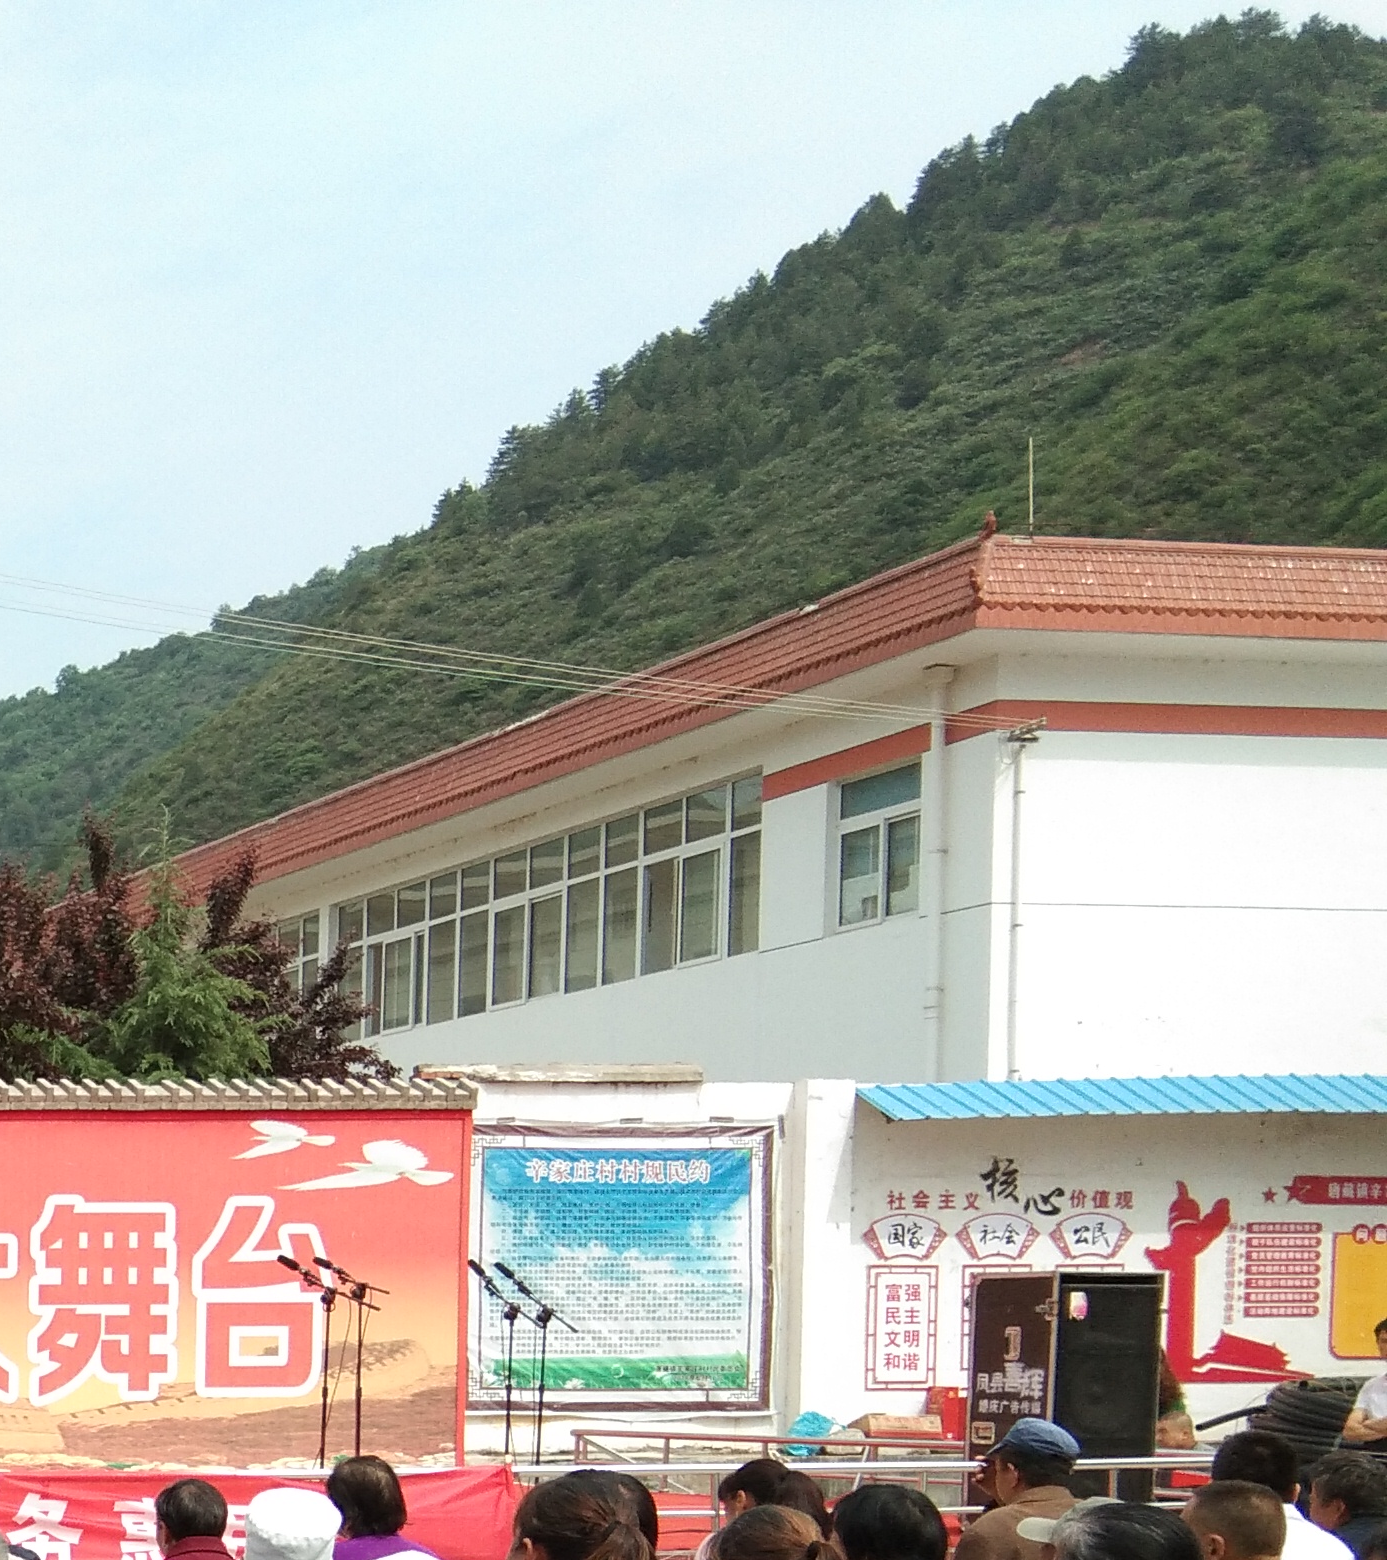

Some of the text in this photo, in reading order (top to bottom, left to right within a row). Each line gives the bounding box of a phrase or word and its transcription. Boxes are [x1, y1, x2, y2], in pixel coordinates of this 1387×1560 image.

[526, 1158, 712, 1184] 辛家庄村村规民约
[887, 1157, 1135, 1216] 社会主义 核心 价值观
[1328, 1182, 1387, 1200] 唐藏镇辛
[888, 1223, 926, 1250] 国家
[979, 1222, 1021, 1246] 社会
[1073, 1221, 1111, 1248] 公民
[885, 1284, 922, 1302] 富强
[885, 1307, 921, 1325] 民主
[884, 1330, 920, 1348] 文明
[883, 1352, 920, 1371] 和谐
